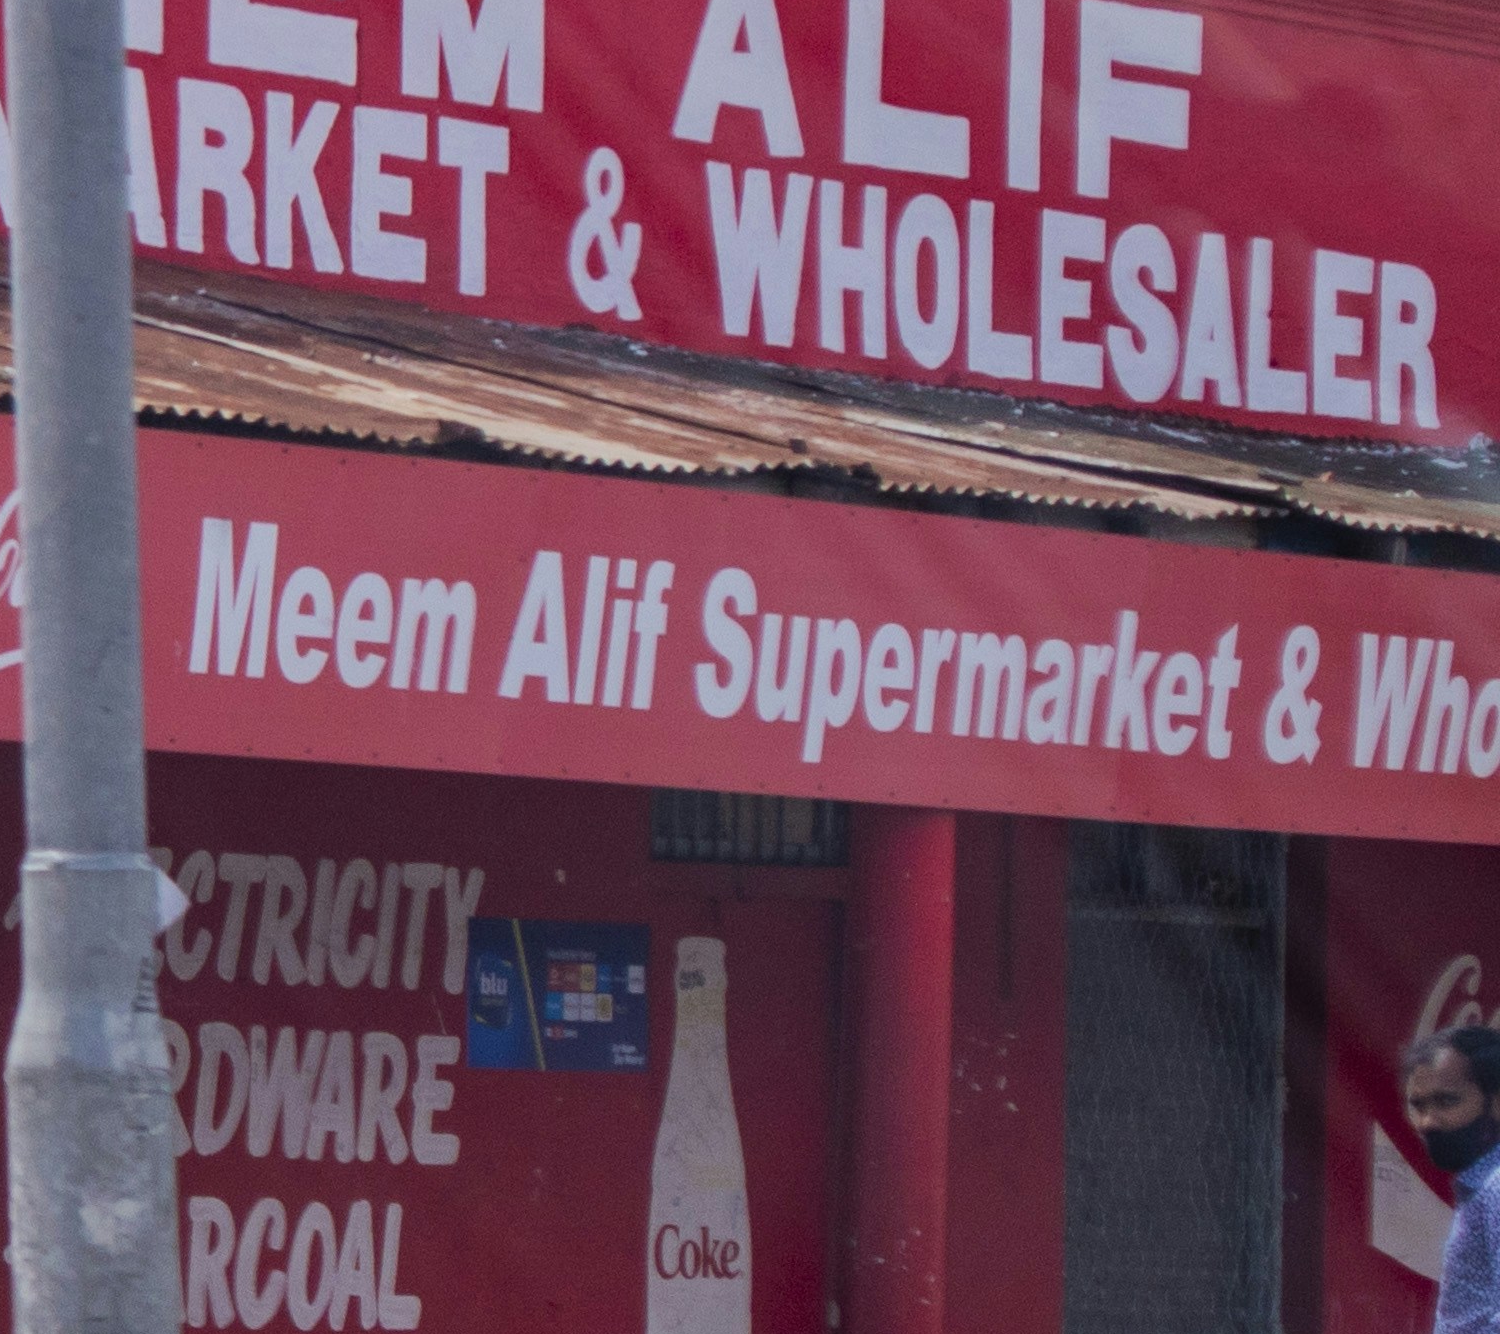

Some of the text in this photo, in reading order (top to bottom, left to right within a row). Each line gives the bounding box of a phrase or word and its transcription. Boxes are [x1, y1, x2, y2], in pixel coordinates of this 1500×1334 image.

[568, 147, 642, 321] &
[705, 161, 1440, 429] WHOLESALER
[189, 517, 477, 695] Meem
[498, 550, 676, 711] Alif
[695, 567, 1242, 764] Supermarket
[1263, 624, 1323, 765] &
[653, 1224, 740, 1281] Coke
